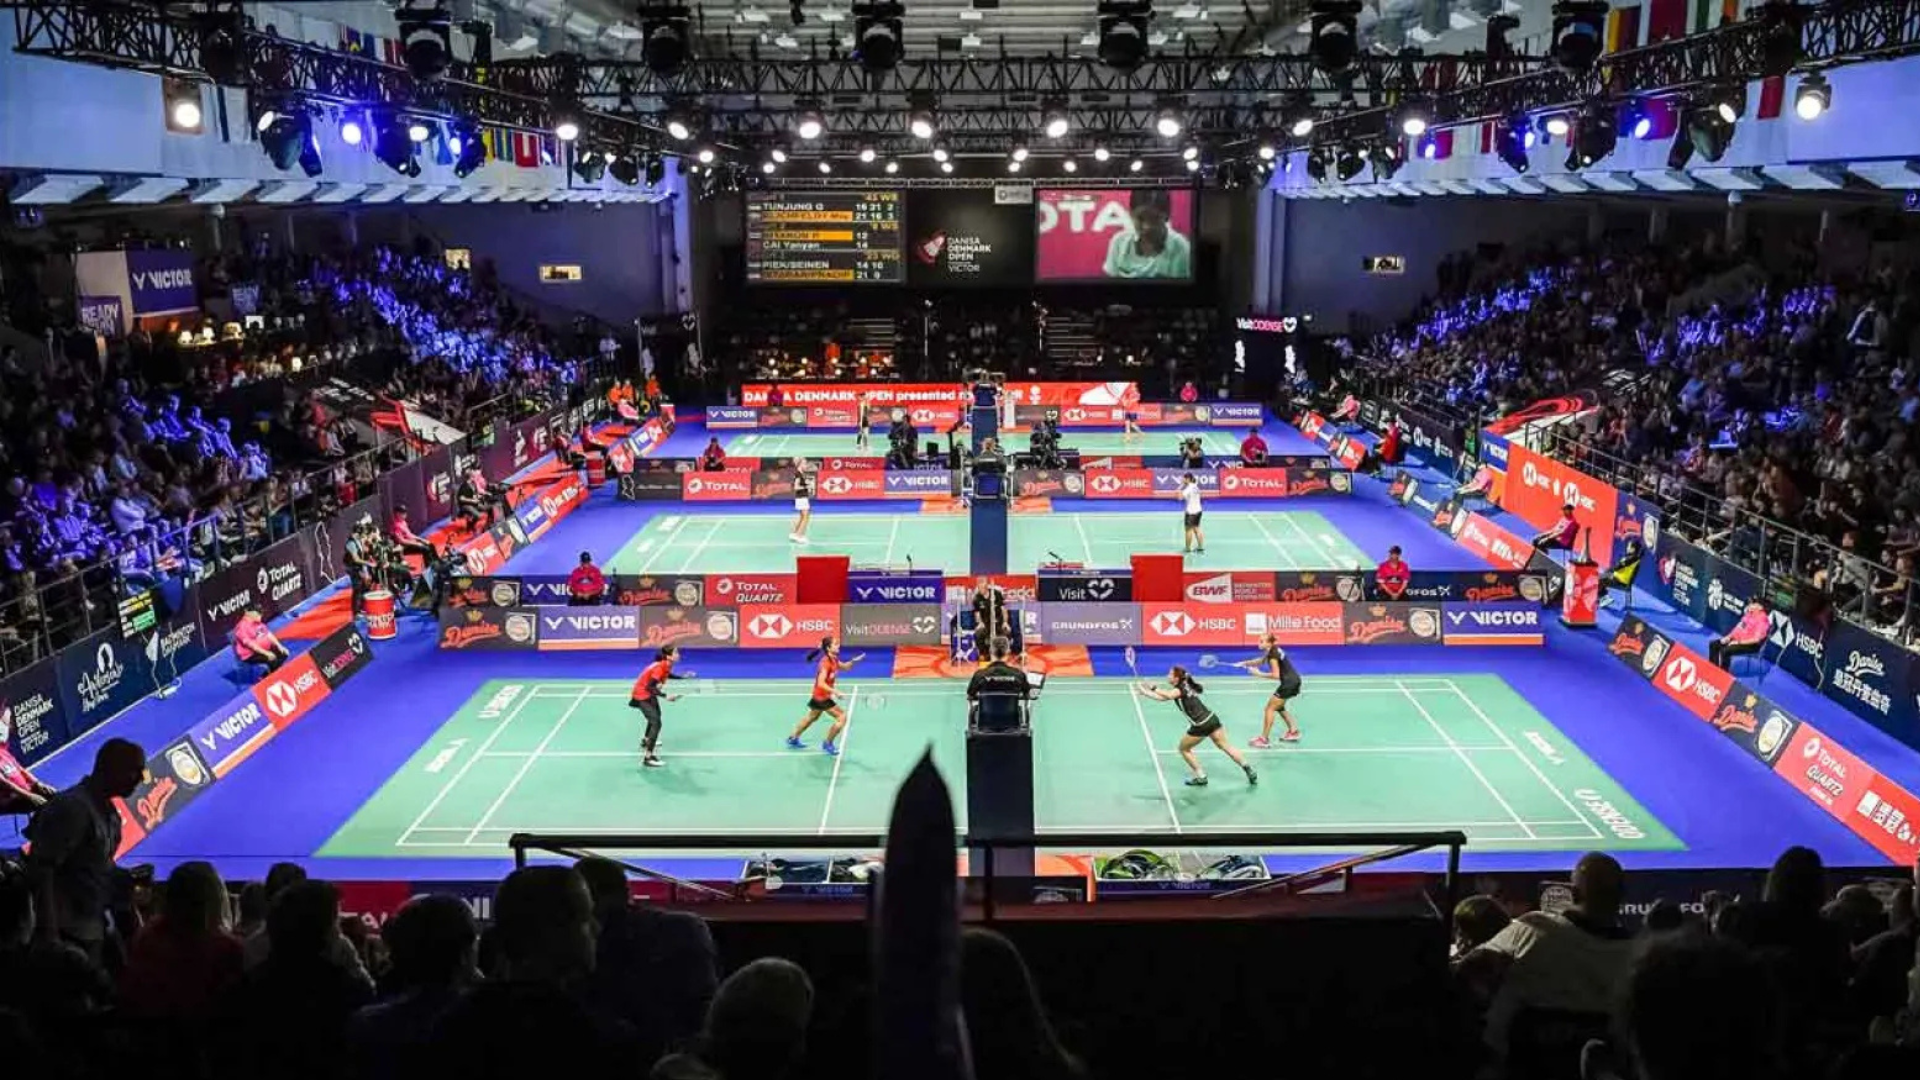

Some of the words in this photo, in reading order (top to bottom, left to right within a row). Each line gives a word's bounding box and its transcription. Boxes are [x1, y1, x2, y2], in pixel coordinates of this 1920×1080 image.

[947, 244, 992, 252] DENMARK
[948, 253, 974, 261] OPEN
[947, 264, 980, 272] VICTOR
[148, 269, 193, 289] VICTOR
[81, 303, 119, 323] READY
[794, 389, 856, 401] DENMARK
[896, 390, 956, 402] presented
[722, 410, 756, 418] VICTOR
[1226, 408, 1261, 416] VICTOR
[844, 460, 873, 469] TOTAL
[704, 482, 748, 491] TOTAL
[903, 475, 948, 486] VICTOR
[1123, 480, 1149, 489] HSBC
[1241, 478, 1283, 488] TOTAL
[269, 561, 296, 582] TOTAL
[272, 574, 301, 601] QUARTZ
[736, 582, 777, 591] TOTAL
[877, 586, 935, 599] VICTOR
[1059, 587, 1086, 600] Visit
[1193, 585, 1228, 596] BWF
[219, 589, 250, 616] VICTOR
[736, 593, 784, 603] QUARTZ
[567, 616, 636, 630] VICTOR
[1198, 617, 1237, 630] HSBC
[1269, 615, 1302, 629] Mille
[1304, 615, 1340, 629] Food
[1470, 611, 1537, 625] VICTOR
[795, 620, 834, 632] HSBC
[1051, 621, 1119, 630] GRUNDFOS
[1346, 615, 1407, 644] Danisa
[440, 620, 502, 648] Danisa
[641, 620, 701, 649] Danisa
[1796, 632, 1825, 659] HSBC
[1845, 650, 1885, 677] Danisa
[294, 669, 321, 696] HSBC
[1693, 677, 1721, 705] HSBC
[15, 698, 54, 728] DENMARK
[1713, 704, 1758, 733] Danisa
[215, 702, 262, 740] VICTOR
[18, 719, 40, 738] OPEN
[1818, 748, 1846, 778] TOTAL
[1806, 764, 1844, 797] QUARTZ
[1618, 903, 1705, 915] RUFO
